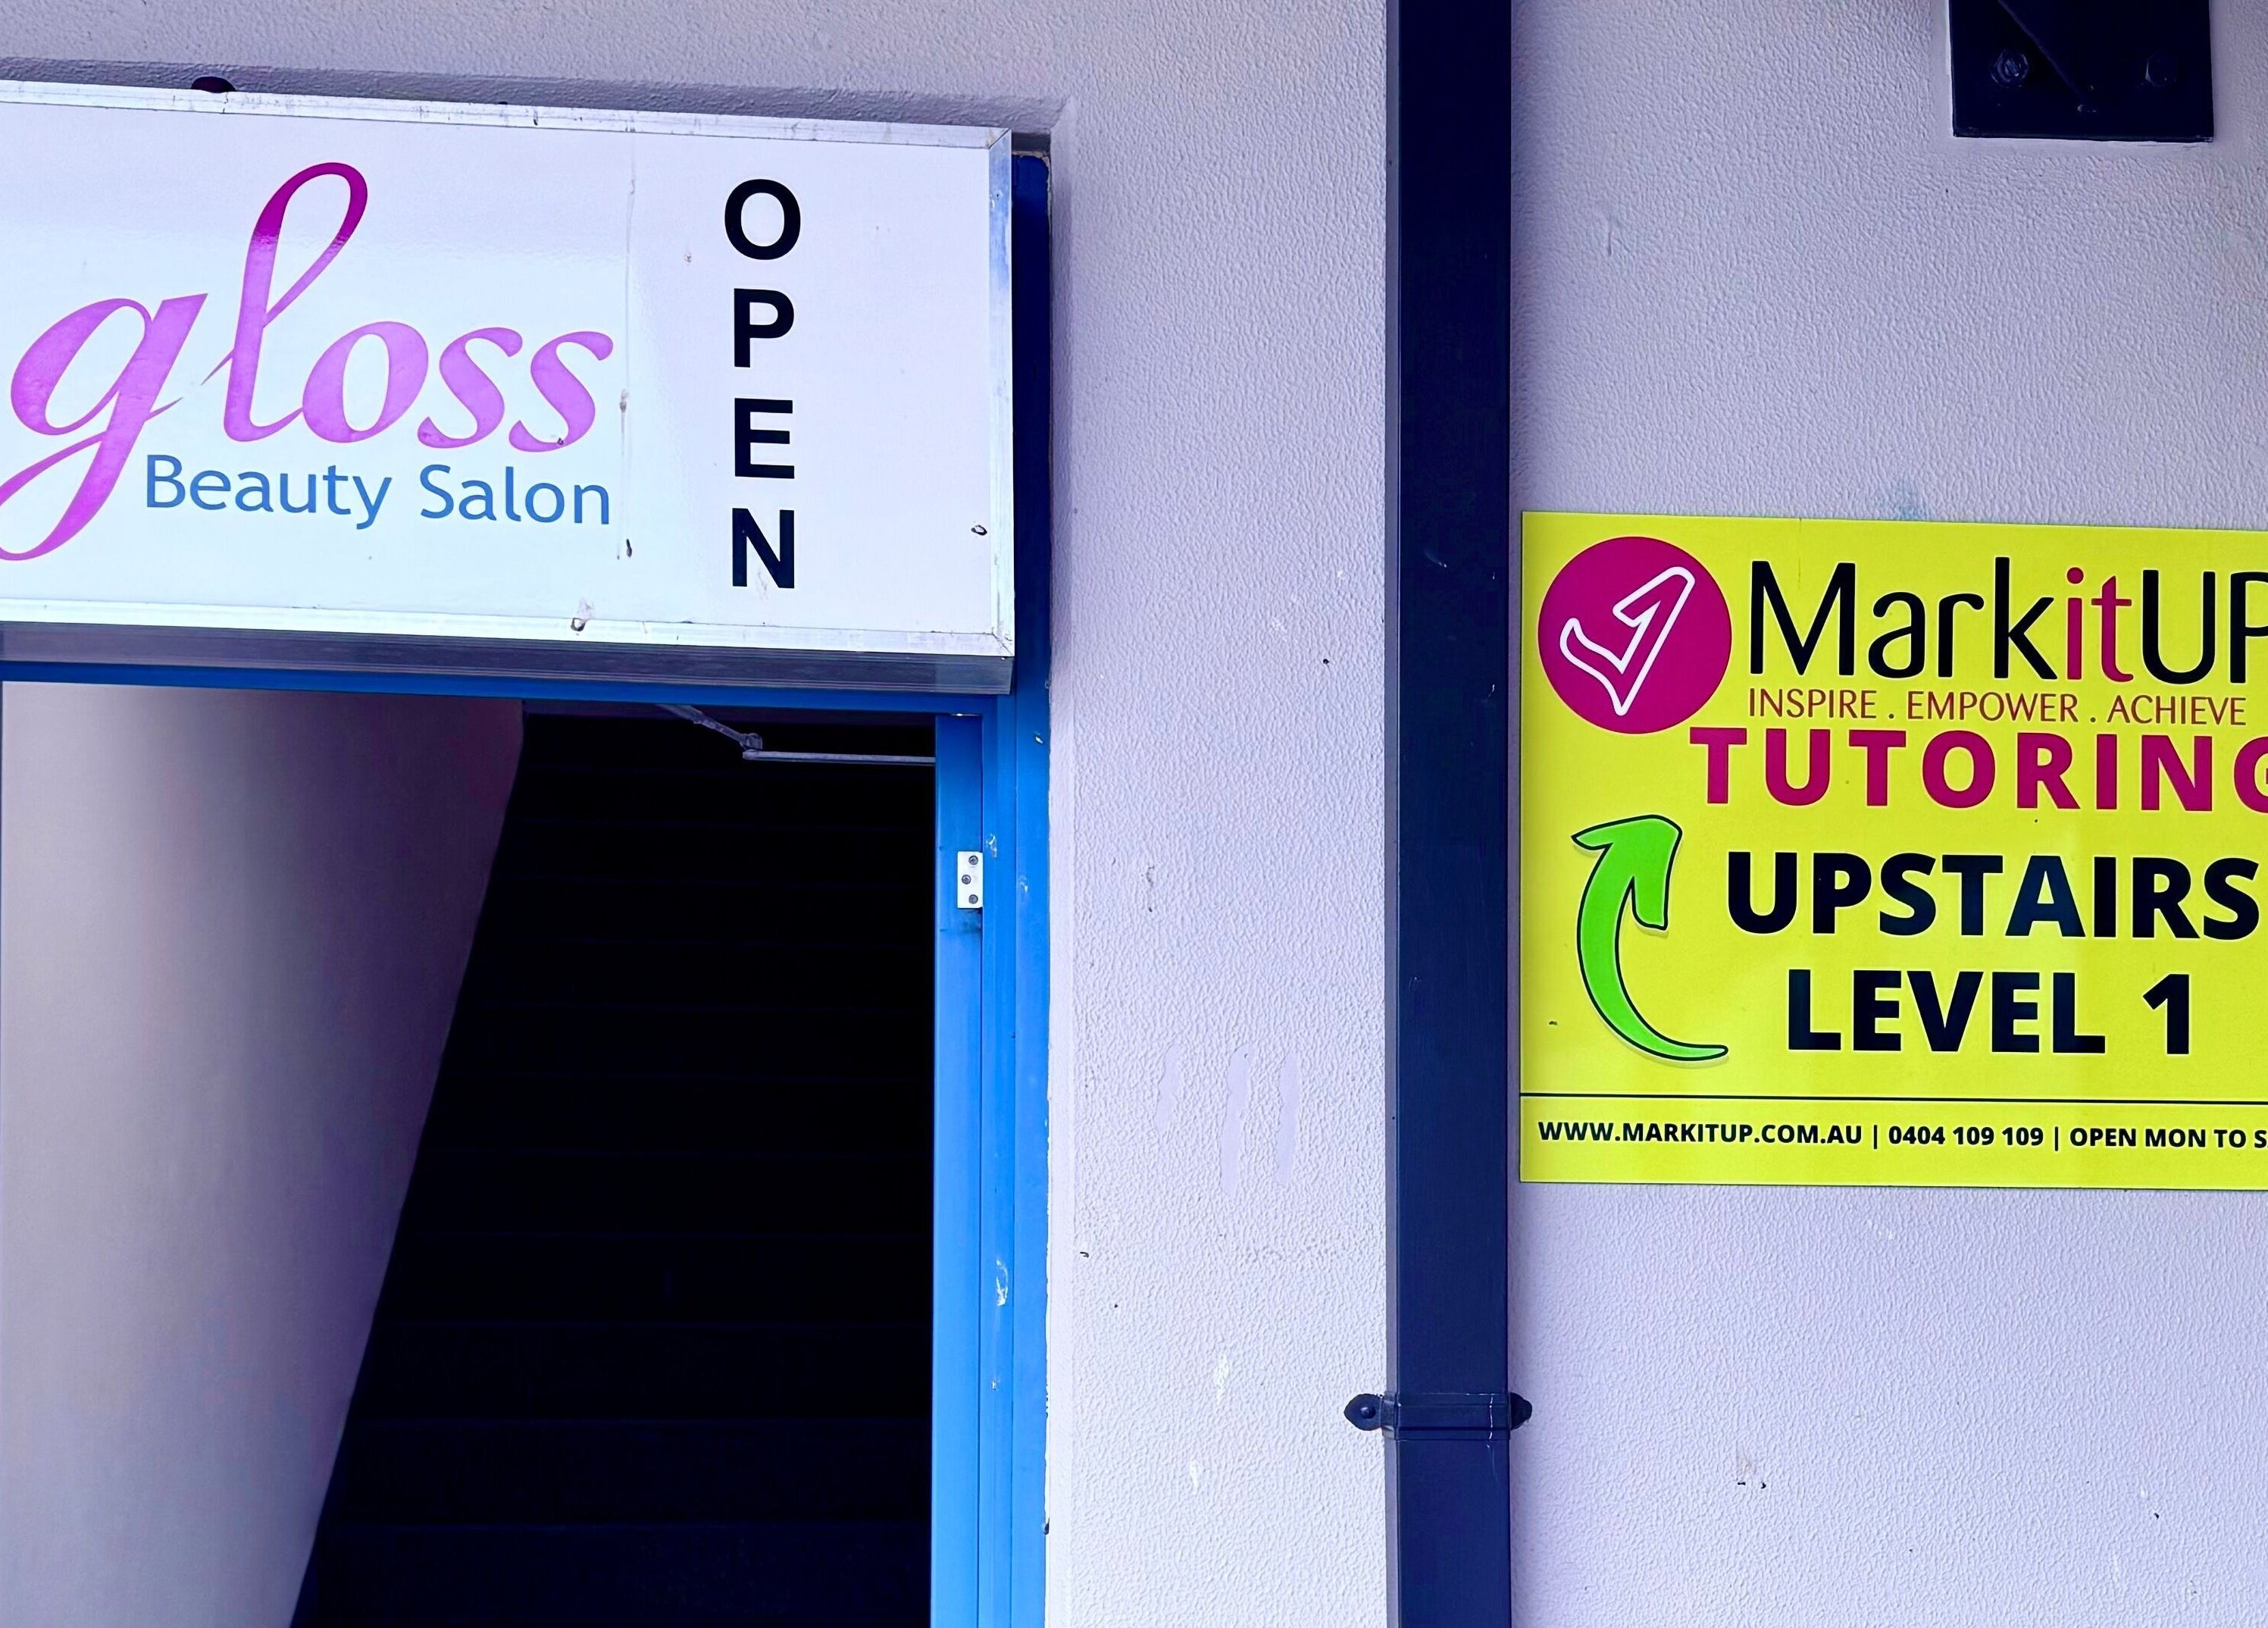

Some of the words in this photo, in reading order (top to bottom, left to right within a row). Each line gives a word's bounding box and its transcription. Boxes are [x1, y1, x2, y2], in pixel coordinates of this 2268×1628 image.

[0, 163, 615, 562] gloss
[724, 178, 801, 590] OPEN
[146, 454, 393, 531] Beauty
[419, 464, 609, 525] Salon
[1750, 556, 2268, 685] MarkitUP
[1749, 687, 1878, 719] INSPIRE
[1907, 690, 2079, 722] EMPOWER
[2107, 694, 2247, 726] ACHIEVE
[1728, 850, 2261, 941] UPSTAIRS
[1788, 968, 2107, 1054] LEVEL
[2142, 973, 2191, 1055] 1
[1538, 1121, 1863, 1144] WWW.MARKITUP.COM.AU
[1888, 1126, 1946, 1145] 0404
[1952, 1126, 1994, 1146] 109
[2001, 1127, 2044, 1147] 109
[2069, 1127, 2137, 1147] OPEN
[2144, 1129, 2206, 1148] MON
[2213, 1129, 2247, 1148] TO
